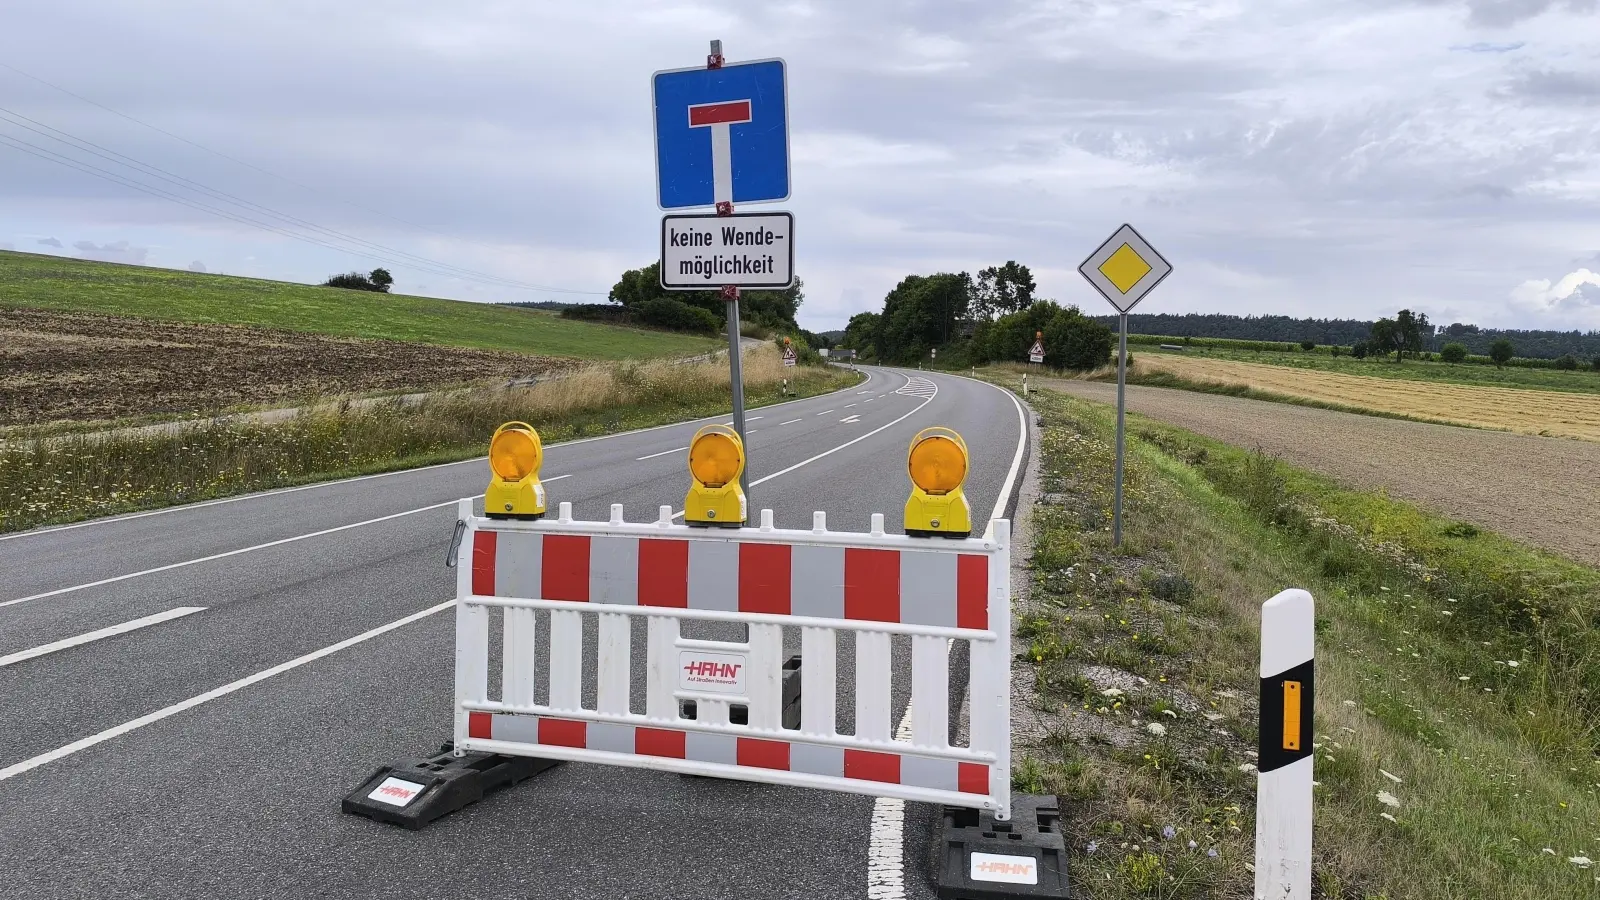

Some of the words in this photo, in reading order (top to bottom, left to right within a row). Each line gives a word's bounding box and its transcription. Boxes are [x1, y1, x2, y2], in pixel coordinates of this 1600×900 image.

[670, 227, 713, 247] keine
[721, 226, 784, 246] Wende-
[679, 254, 774, 280] möglichkeit
[684, 661, 741, 678] HAHN
[380, 786, 416, 799] HAHN
[975, 862, 1033, 875] HAHN
